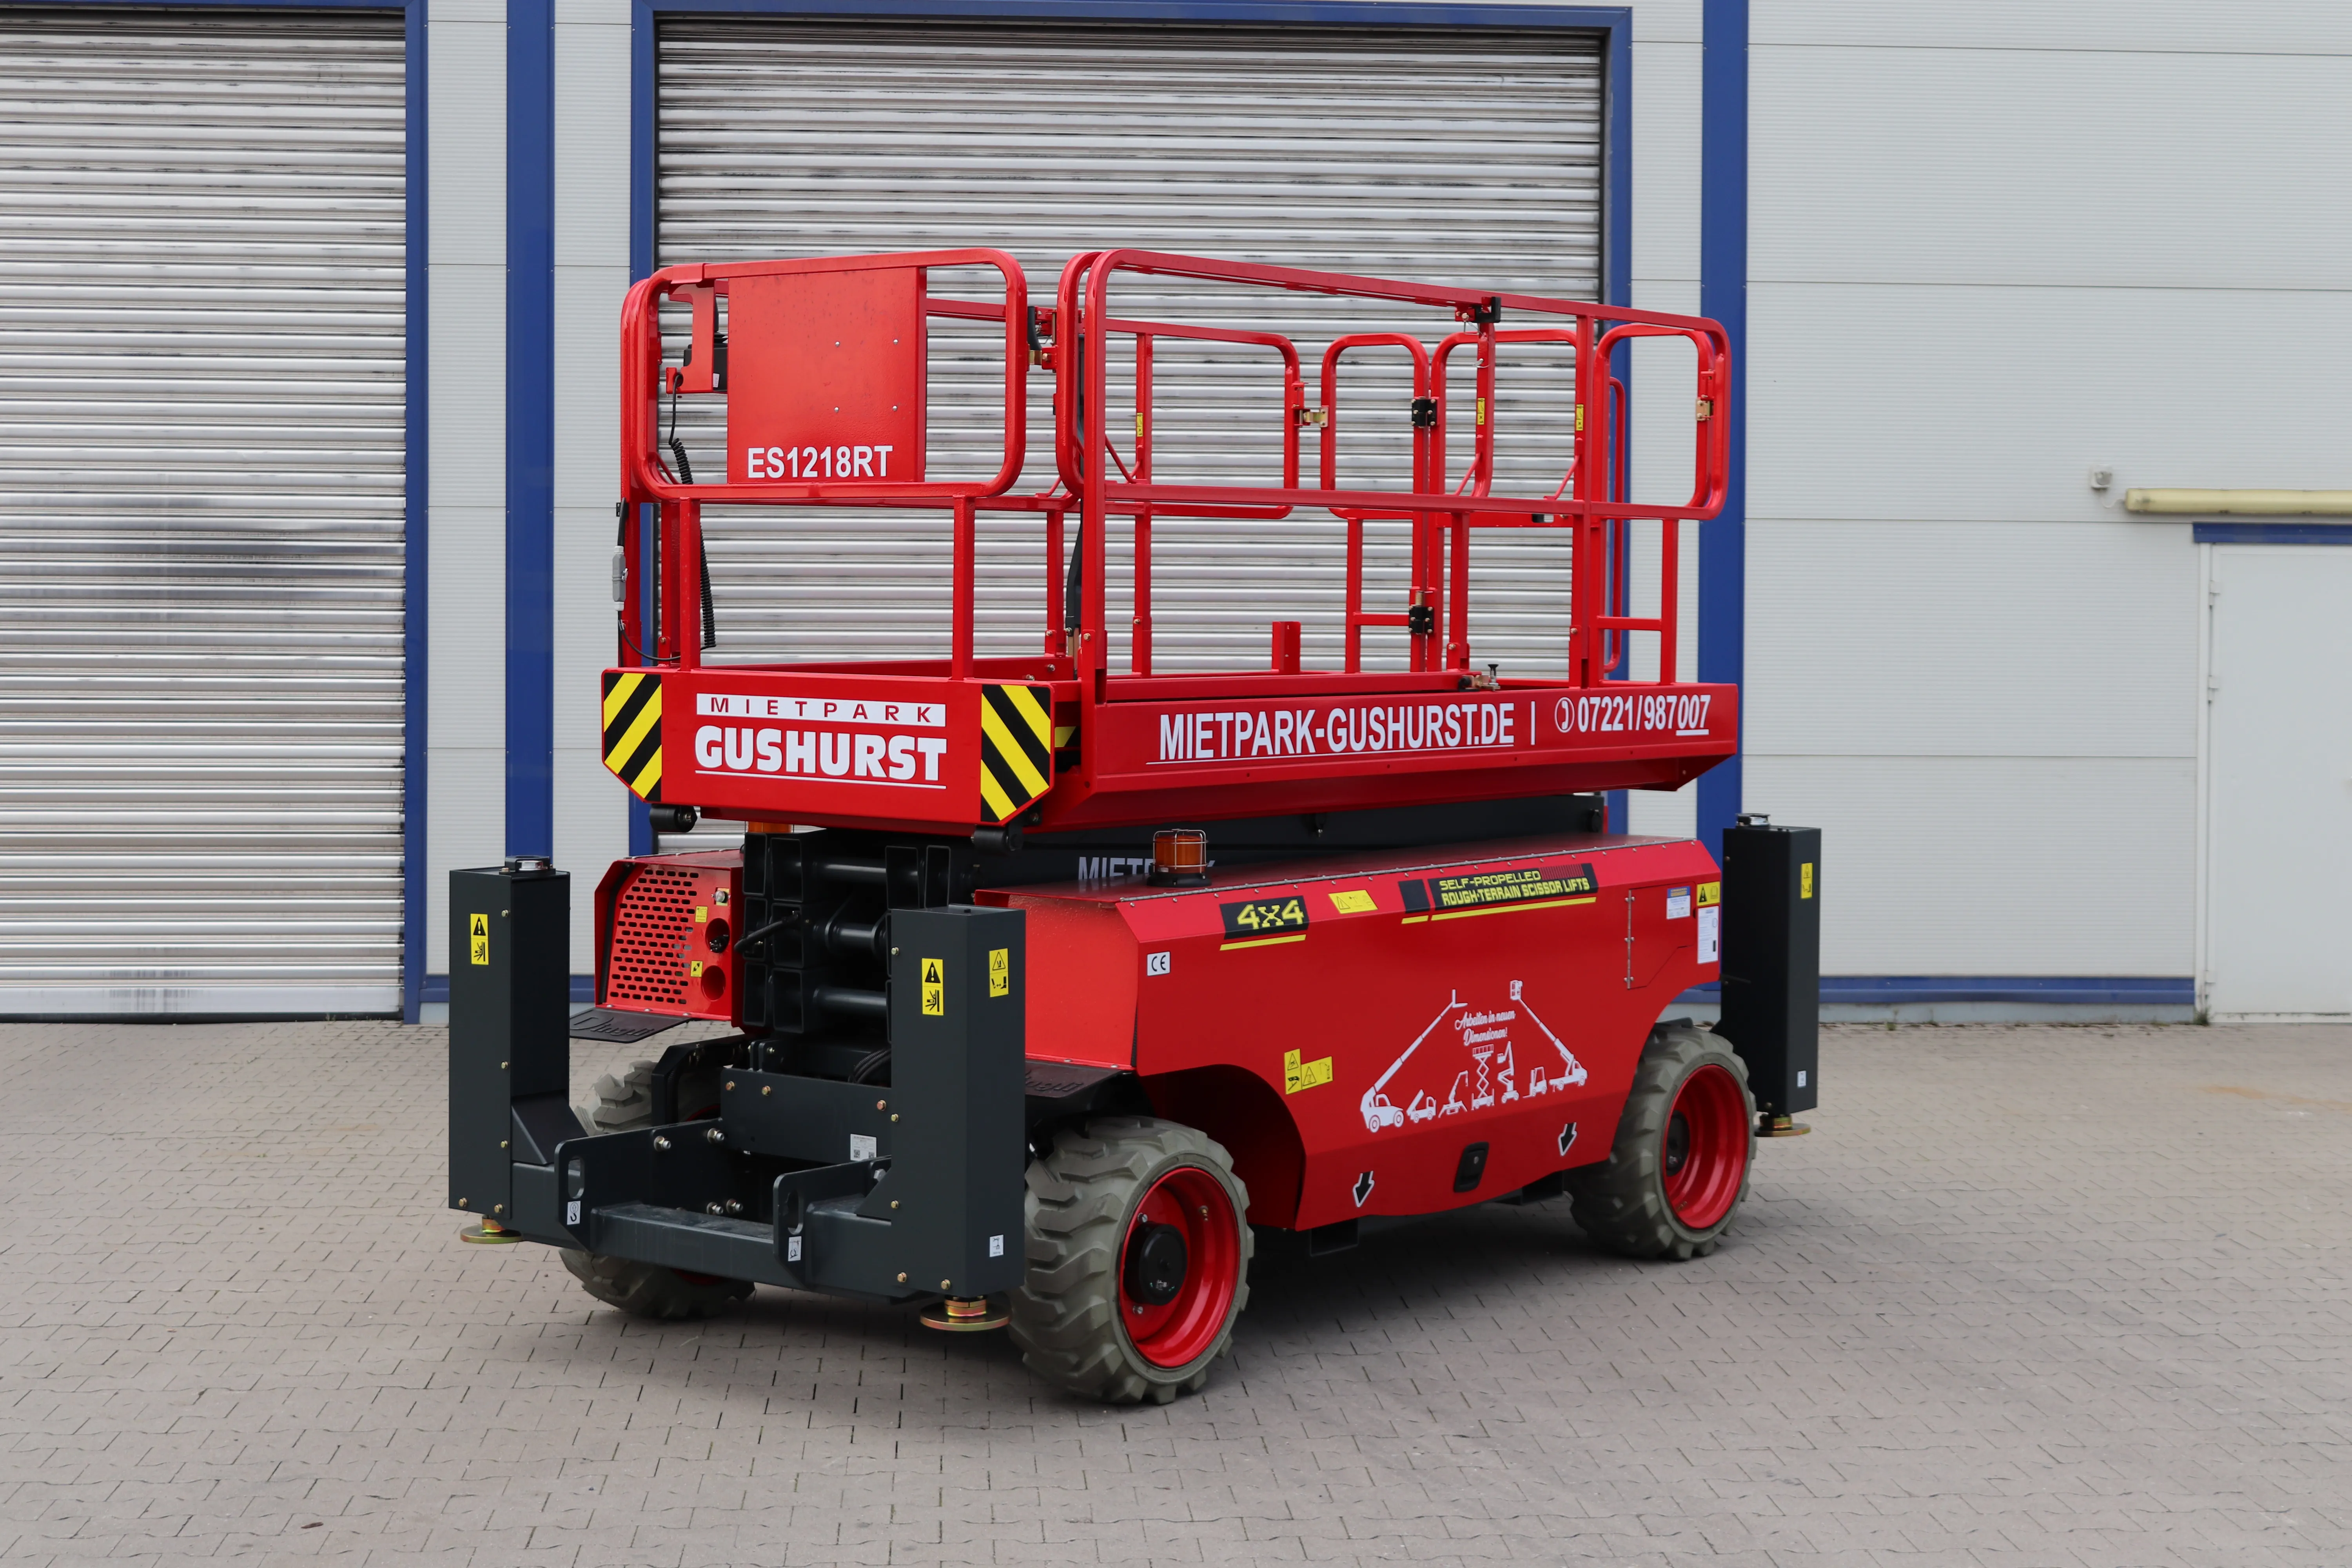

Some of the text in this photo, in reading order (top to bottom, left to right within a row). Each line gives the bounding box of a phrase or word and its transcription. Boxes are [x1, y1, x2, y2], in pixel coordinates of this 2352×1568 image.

[748, 445, 893, 479] ES1218RT
[711, 697, 932, 723] MIETPARK
[1160, 703, 1515, 760] MIETPARK-GUSHURST.DE
[695, 725, 947, 780] GUSHURST
[1439, 870, 1541, 891] SELF-PROPELLED
[1441, 877, 1590, 906] ROUGH-TERRAIN SCISSOR LIFTS
[1455, 1010, 1516, 1030] Arbeiten in neuen
[1463, 1027, 1508, 1046] Dimensionen!
